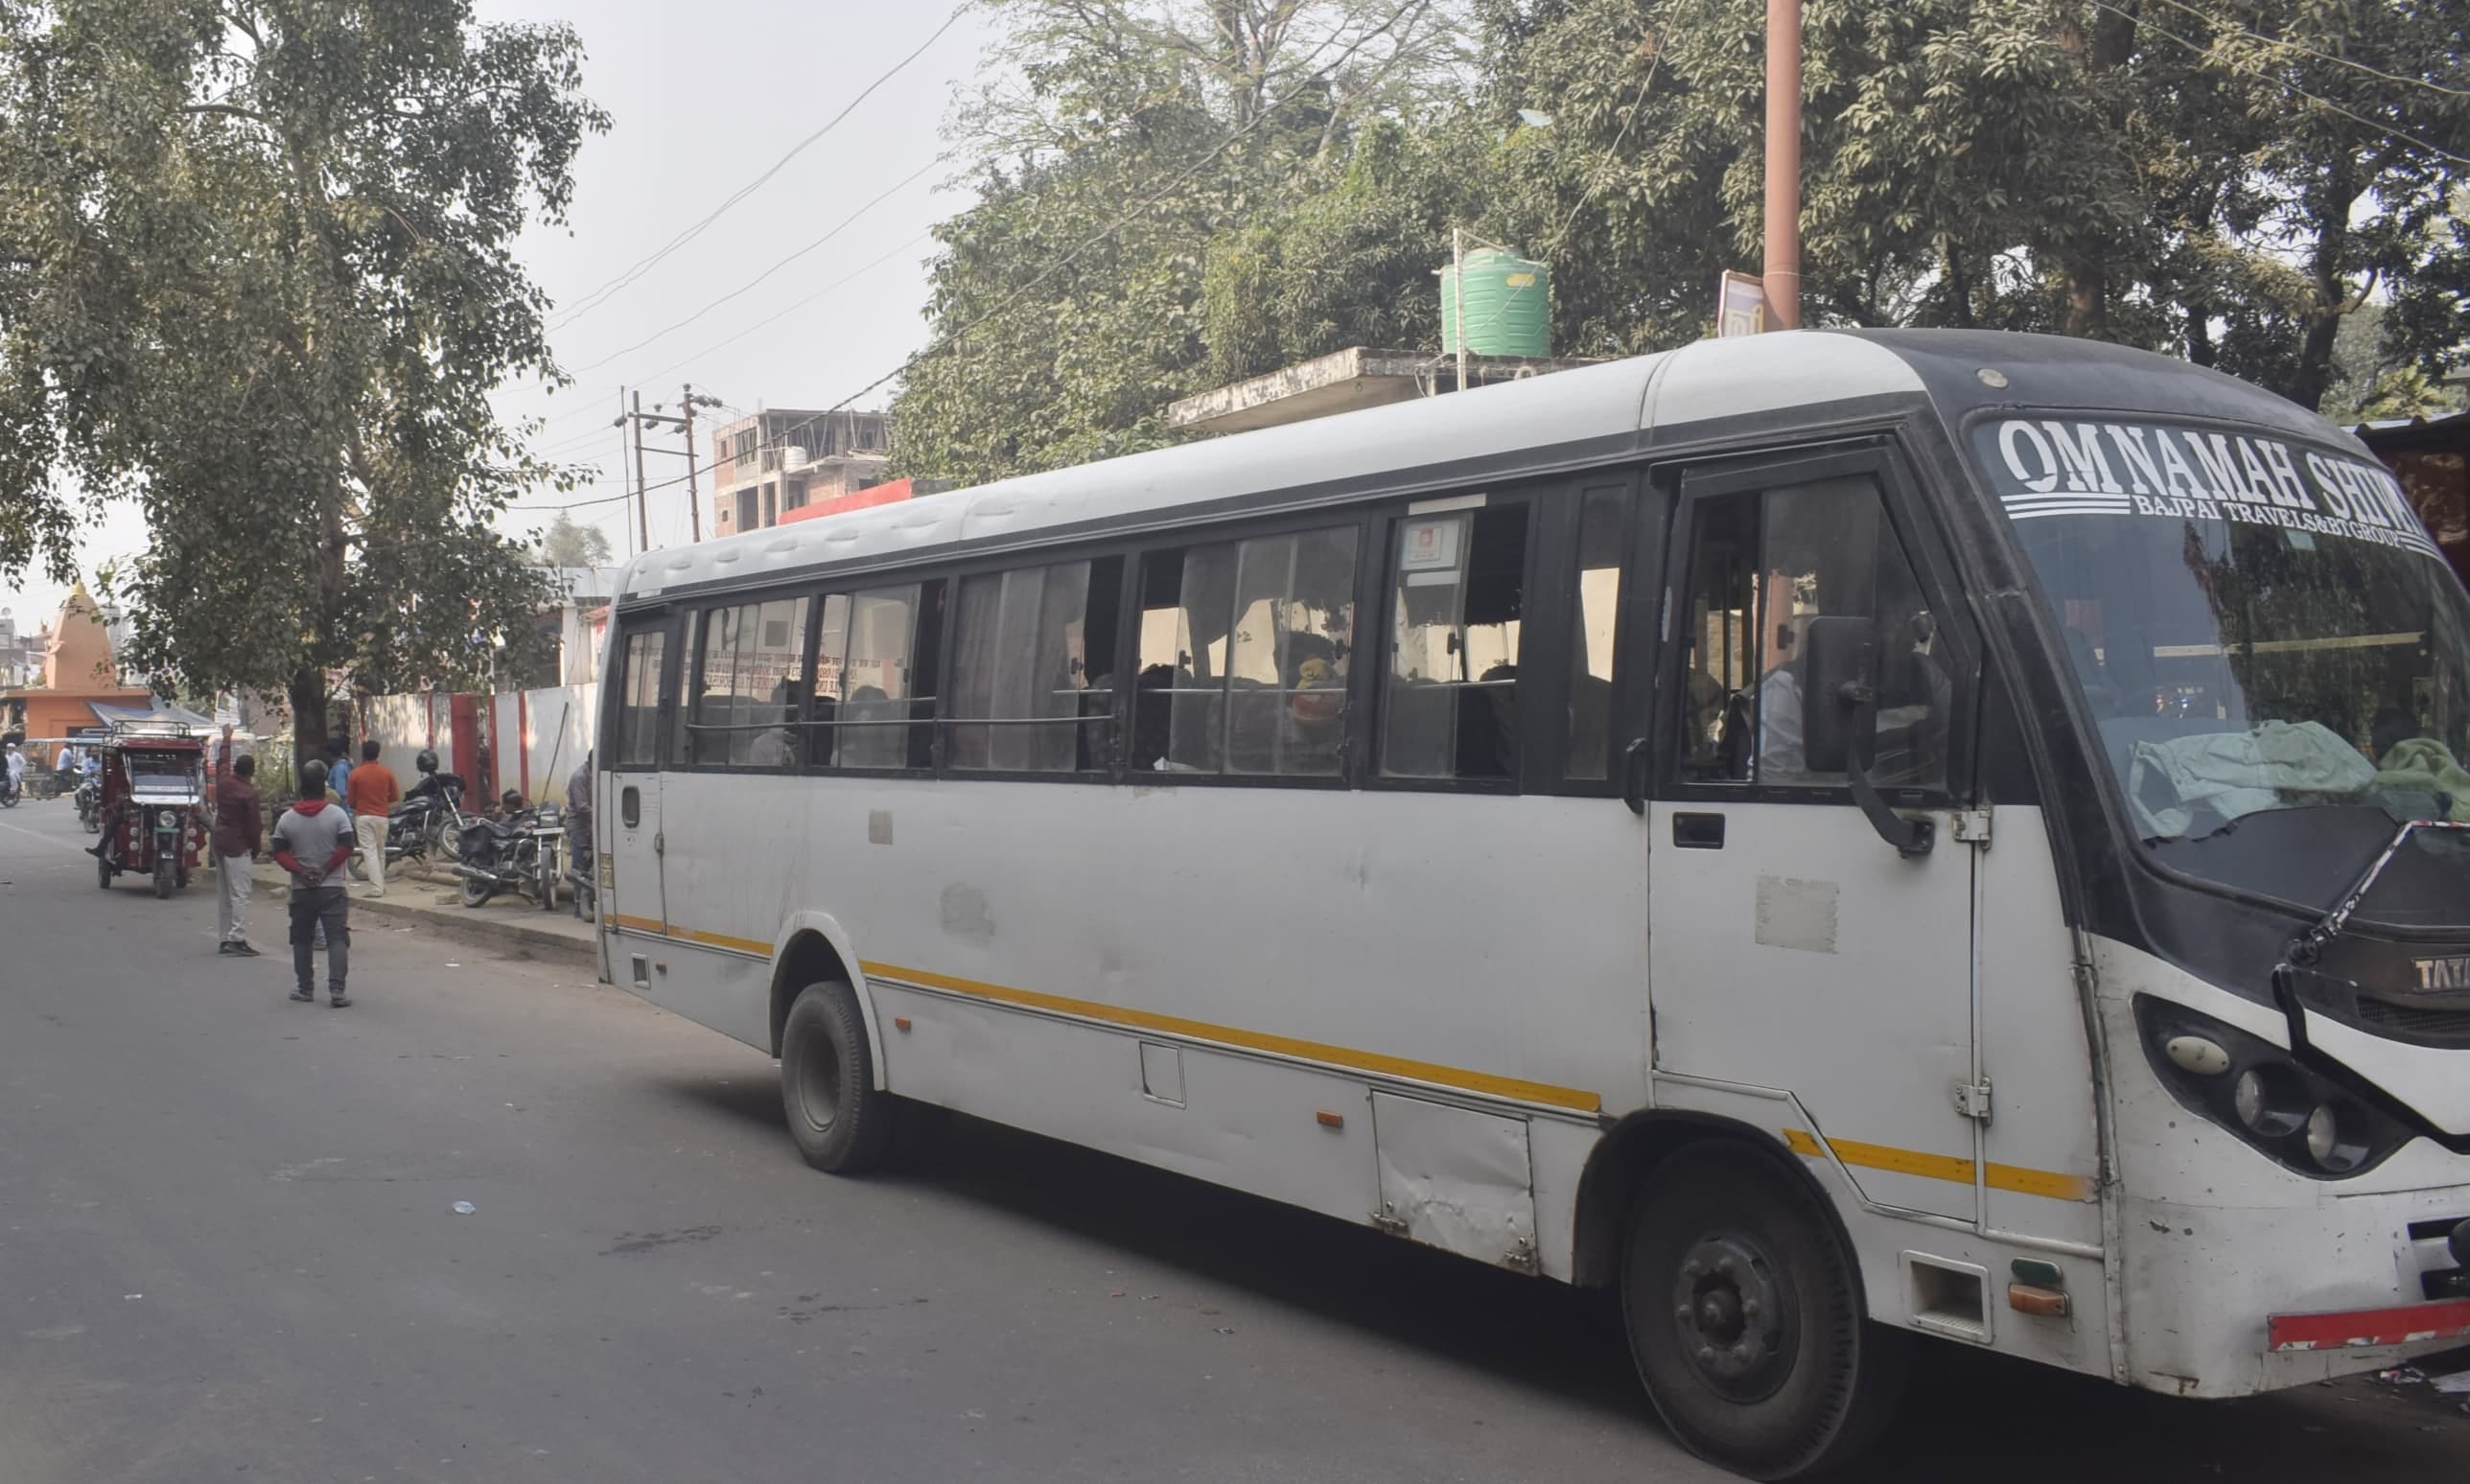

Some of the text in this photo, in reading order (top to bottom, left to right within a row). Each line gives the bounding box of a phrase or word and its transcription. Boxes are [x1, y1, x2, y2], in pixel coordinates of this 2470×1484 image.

[1998, 419, 2124, 494] OM
[2104, 424, 2318, 510] NAMAH
[2132, 494, 2223, 521] BAJPAI
